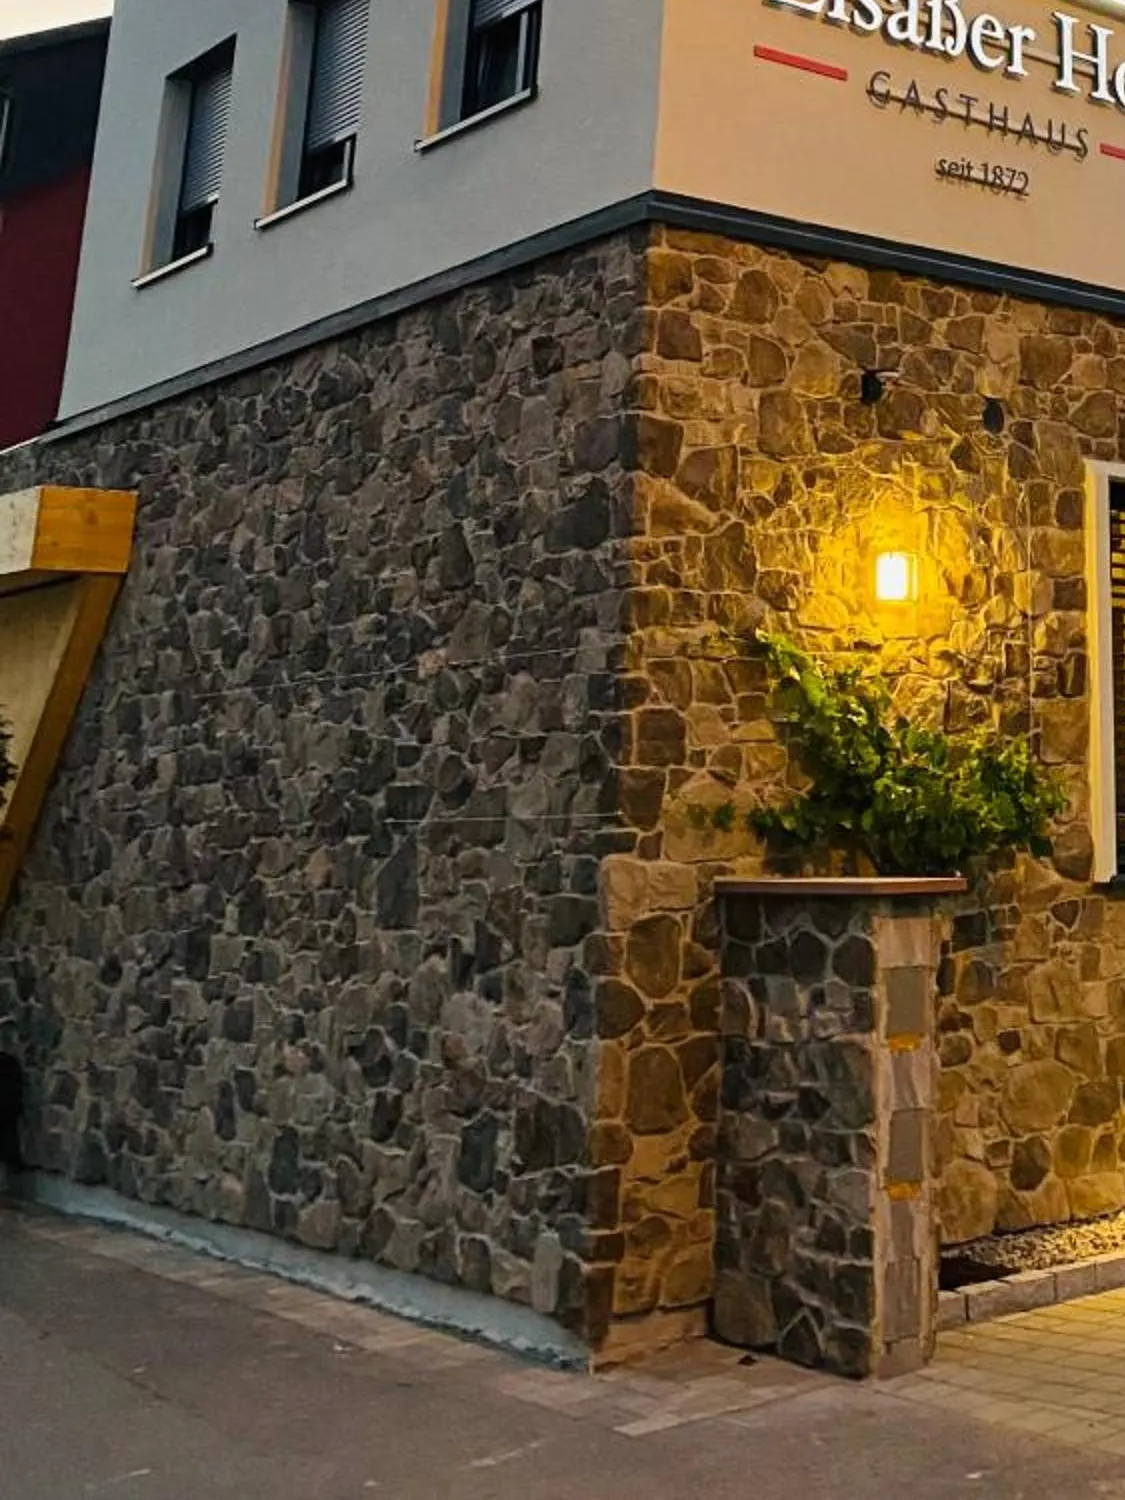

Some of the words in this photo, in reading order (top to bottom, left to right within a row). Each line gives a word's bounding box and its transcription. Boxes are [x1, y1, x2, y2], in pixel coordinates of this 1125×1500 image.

[868, 70, 1089, 159] GASTHAUS
[936, 156, 974, 181] seit
[981, 161, 1030, 196] 1872
